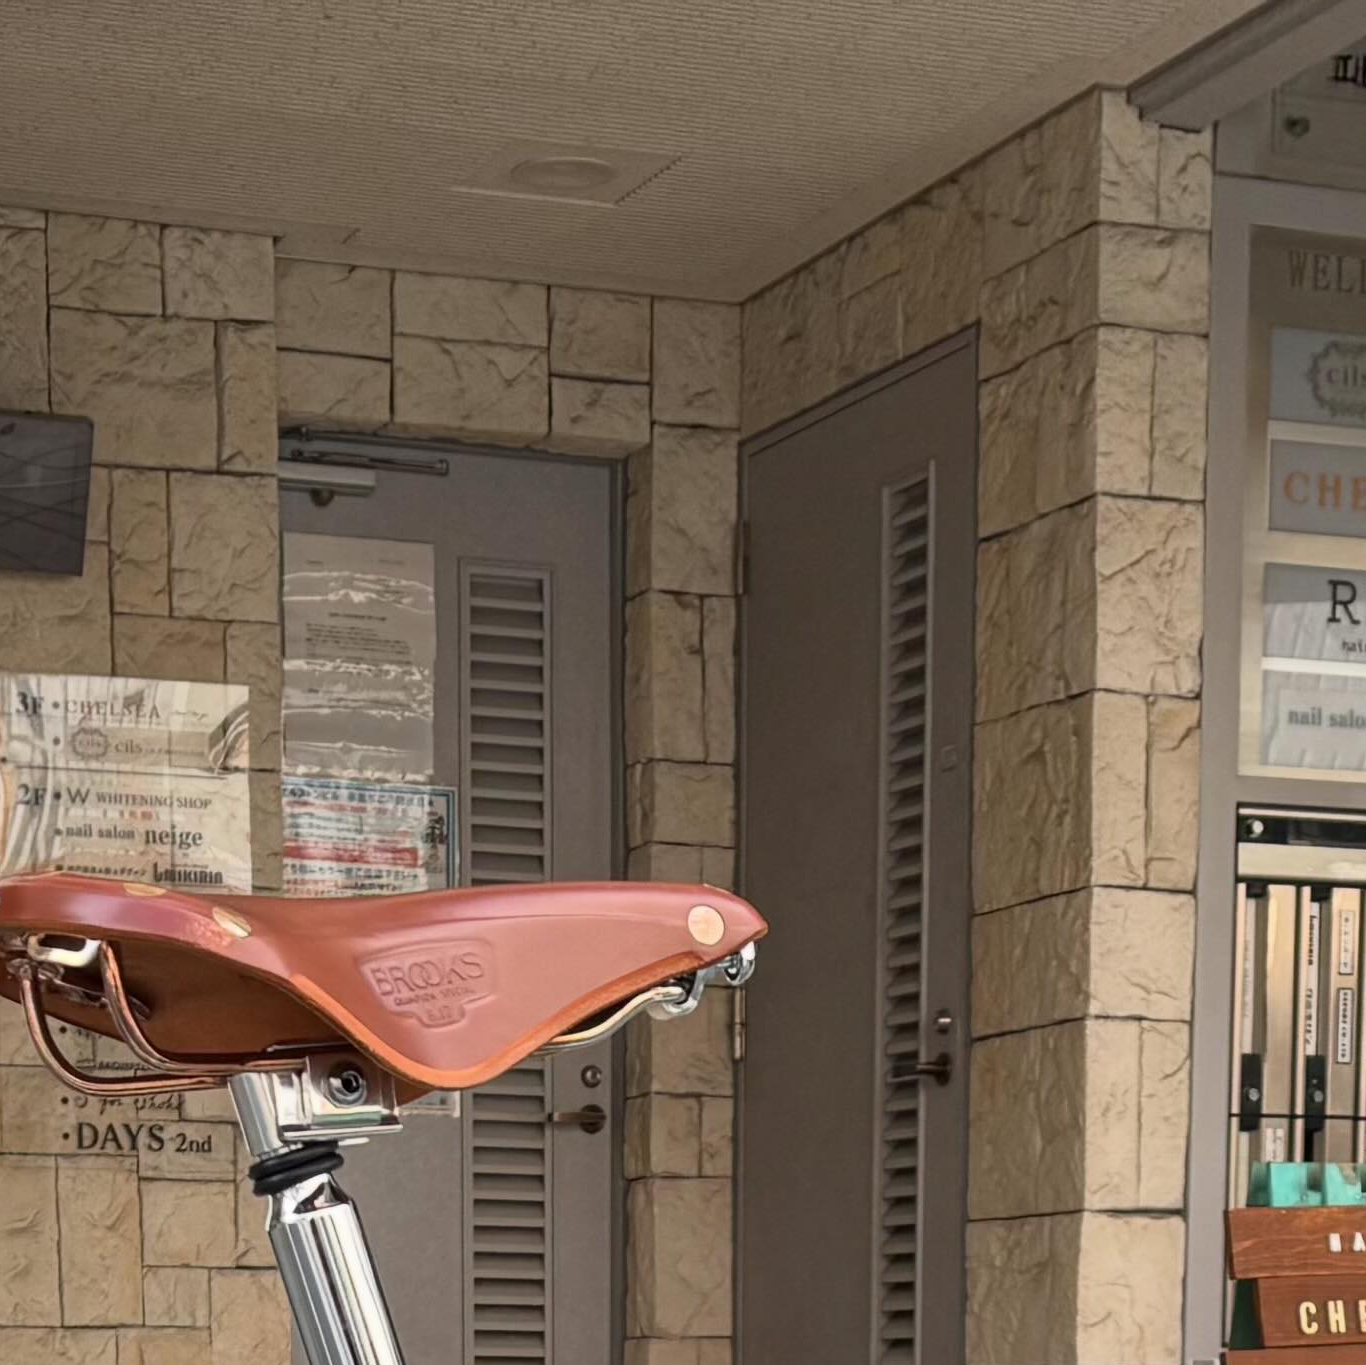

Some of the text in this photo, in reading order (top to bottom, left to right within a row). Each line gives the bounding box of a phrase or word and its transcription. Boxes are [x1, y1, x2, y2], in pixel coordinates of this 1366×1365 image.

[15, 692, 45, 717] 3F
[65, 700, 161, 720] CHELSEA
[1287, 706, 1323, 727] nail
[16, 784, 213, 810] 2F W WHITENING SHOP
[66, 823, 204, 848] nail salon neige
[370, 951, 485, 996] BROOKS
[76, 1121, 213, 1154] DAYS 2nd
